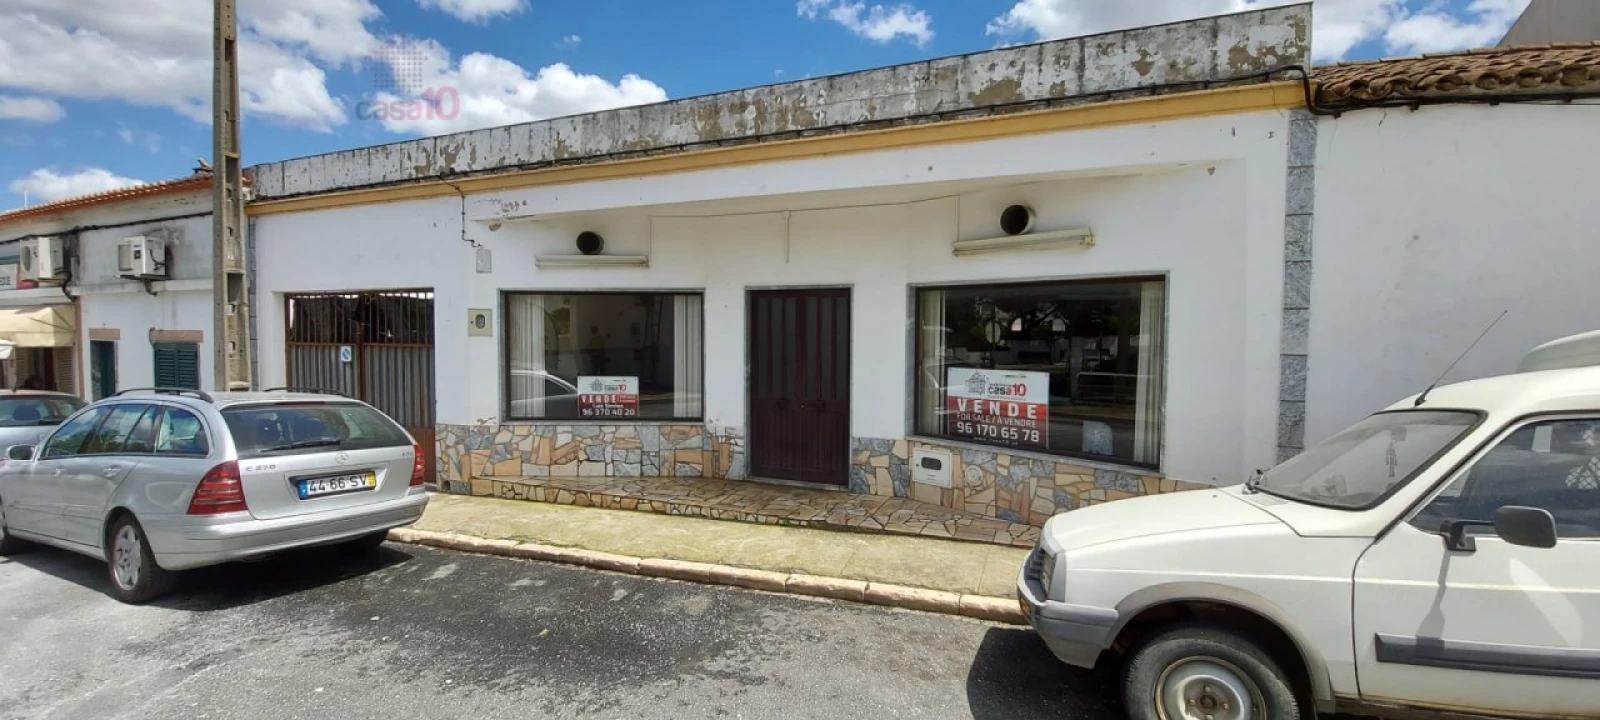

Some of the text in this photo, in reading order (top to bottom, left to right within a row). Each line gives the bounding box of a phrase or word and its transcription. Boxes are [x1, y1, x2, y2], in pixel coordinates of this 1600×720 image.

[988, 383, 1027, 396] casa10
[581, 394, 616, 403] VENDE
[582, 408, 636, 416] 96 370 40 20
[957, 398, 1037, 419] VENDE
[957, 412, 971, 420] FOR
[972, 413, 991, 423] SALE
[1004, 418, 1037, 428] VENDRE
[956, 421, 973, 434] 96
[976, 423, 998, 437] 170
[1000, 426, 1018, 440] 65
[1022, 428, 1040, 442] 78
[309, 474, 368, 492] 44 66 SV
